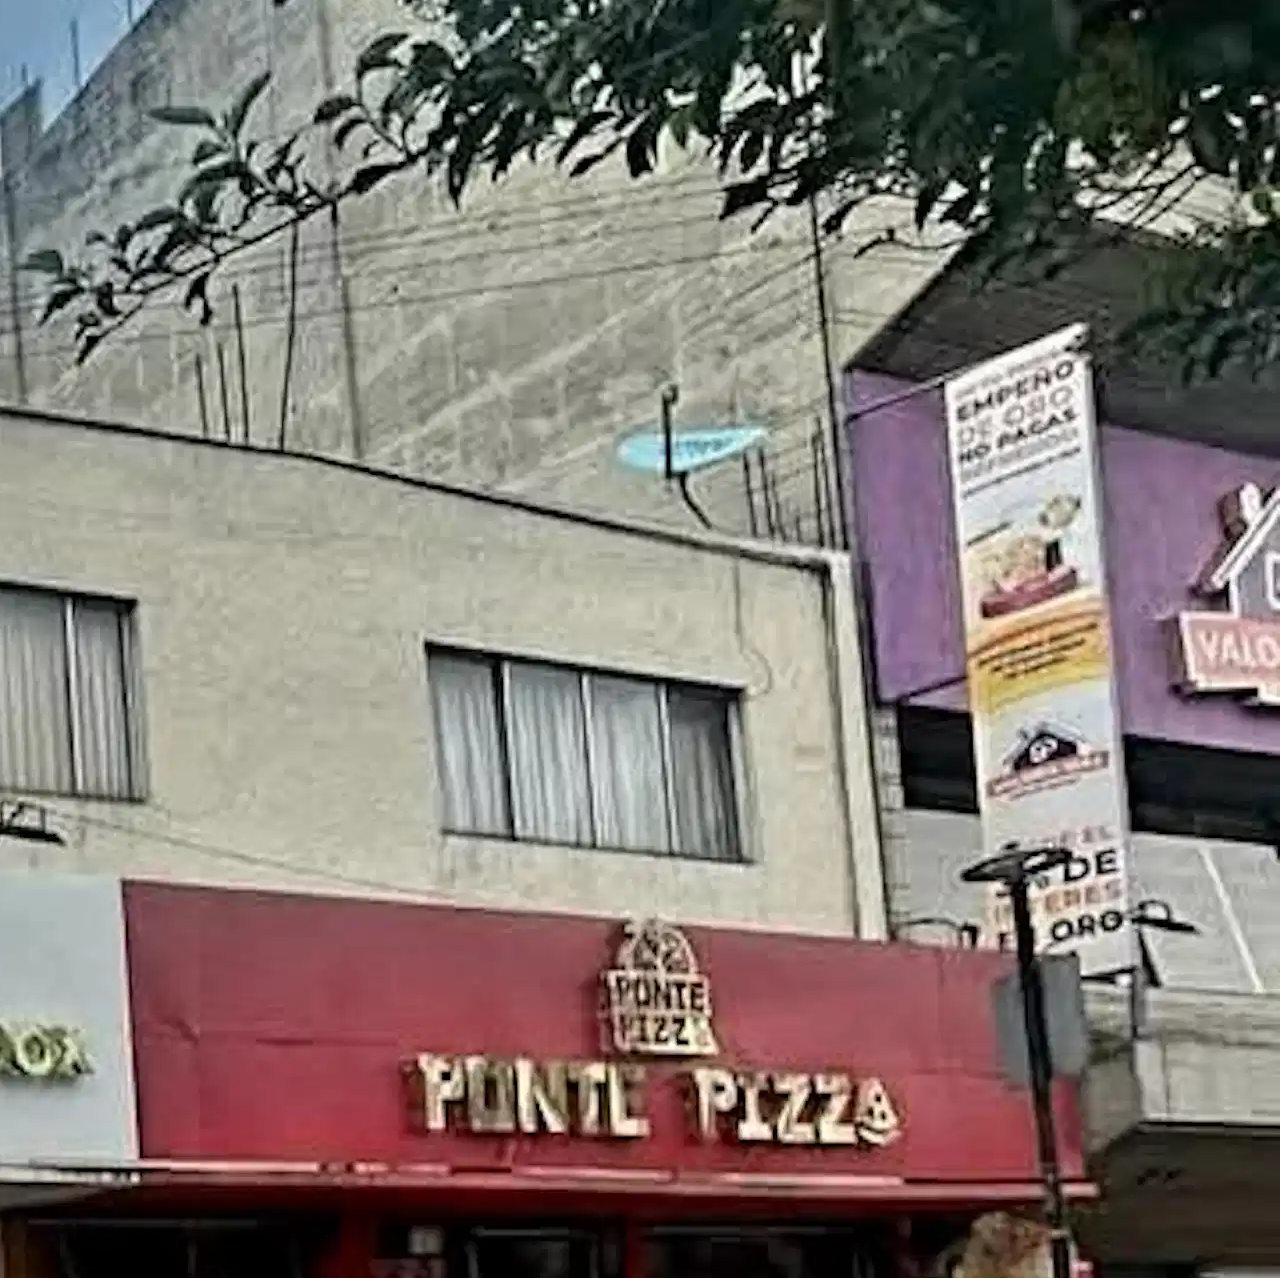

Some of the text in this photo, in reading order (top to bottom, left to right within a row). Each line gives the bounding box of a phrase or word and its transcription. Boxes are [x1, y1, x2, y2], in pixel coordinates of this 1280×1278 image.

[1063, 847, 1118, 882] DE
[1051, 910, 1124, 942] ORO
[614, 976, 704, 1010] PONTE
[416, 1053, 652, 1138] PONTE
